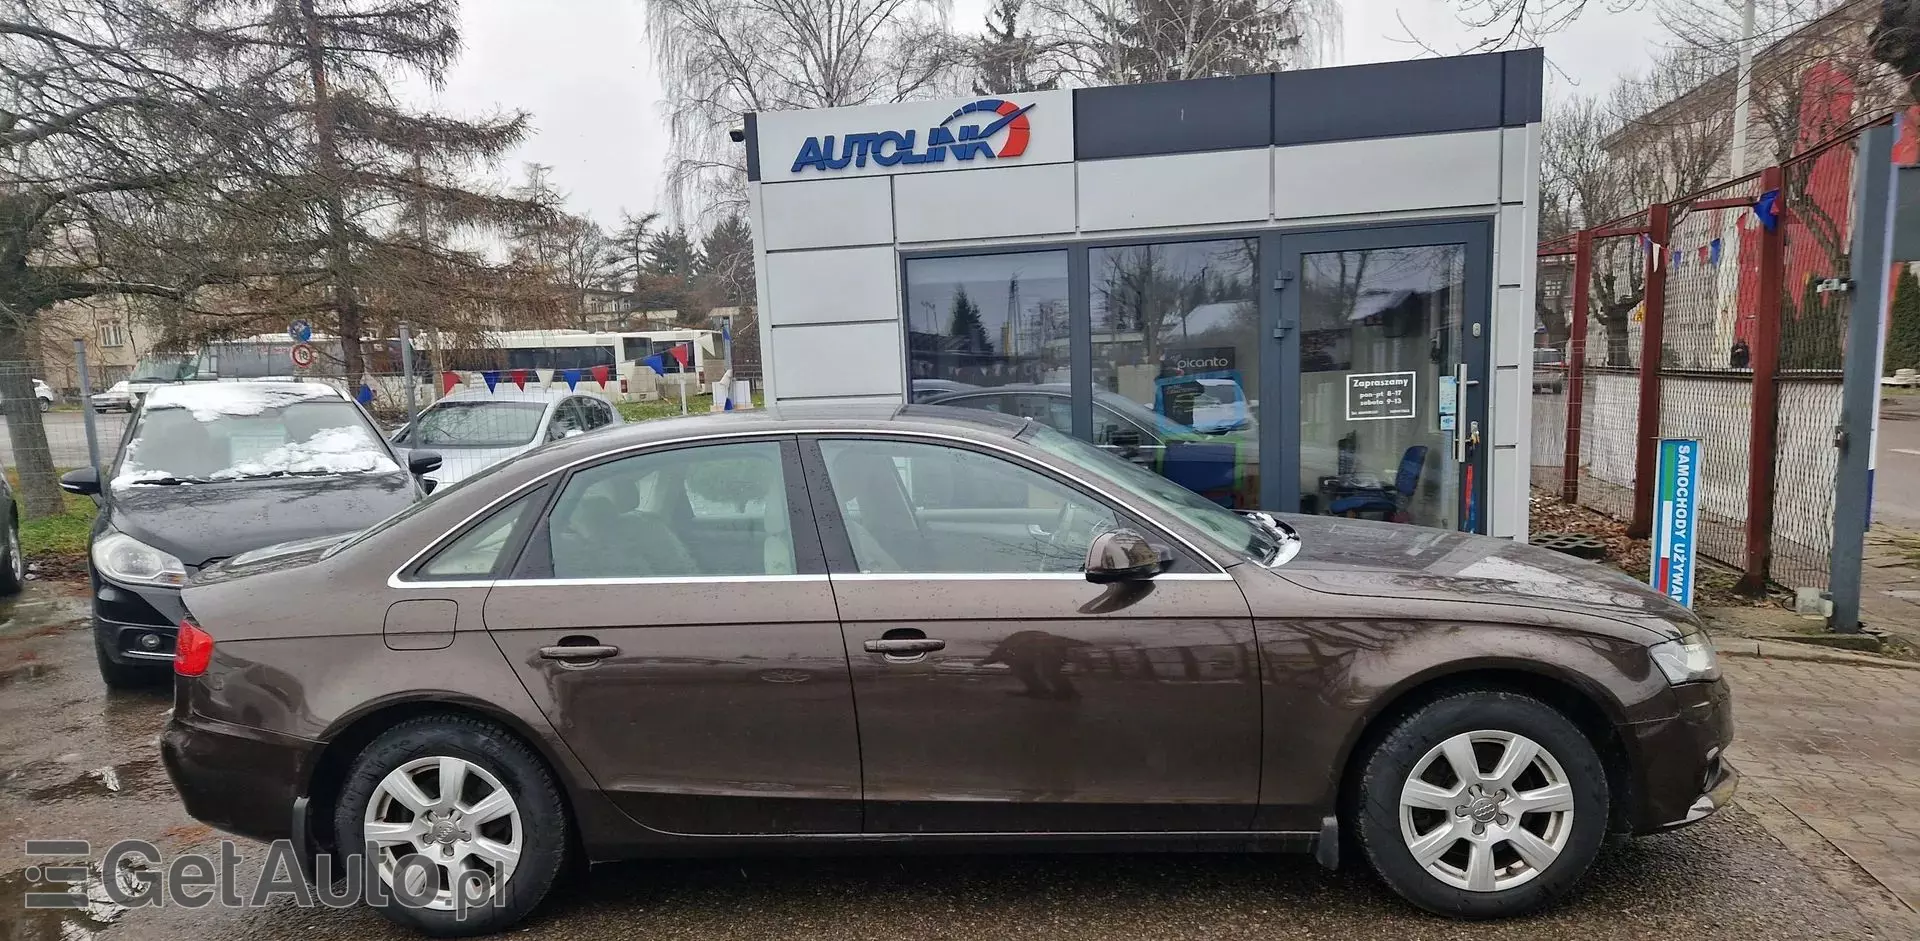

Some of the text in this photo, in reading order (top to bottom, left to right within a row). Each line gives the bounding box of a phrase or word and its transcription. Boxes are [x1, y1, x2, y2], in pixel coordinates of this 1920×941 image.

[791, 124, 997, 173] AUTOLINK
[1177, 357, 1229, 369] picanto
[1353, 379, 1409, 388] Zapraszamy
[1360, 391, 1384, 399] pon-pt
[1674, 445, 1690, 539] SAMOCHODY
